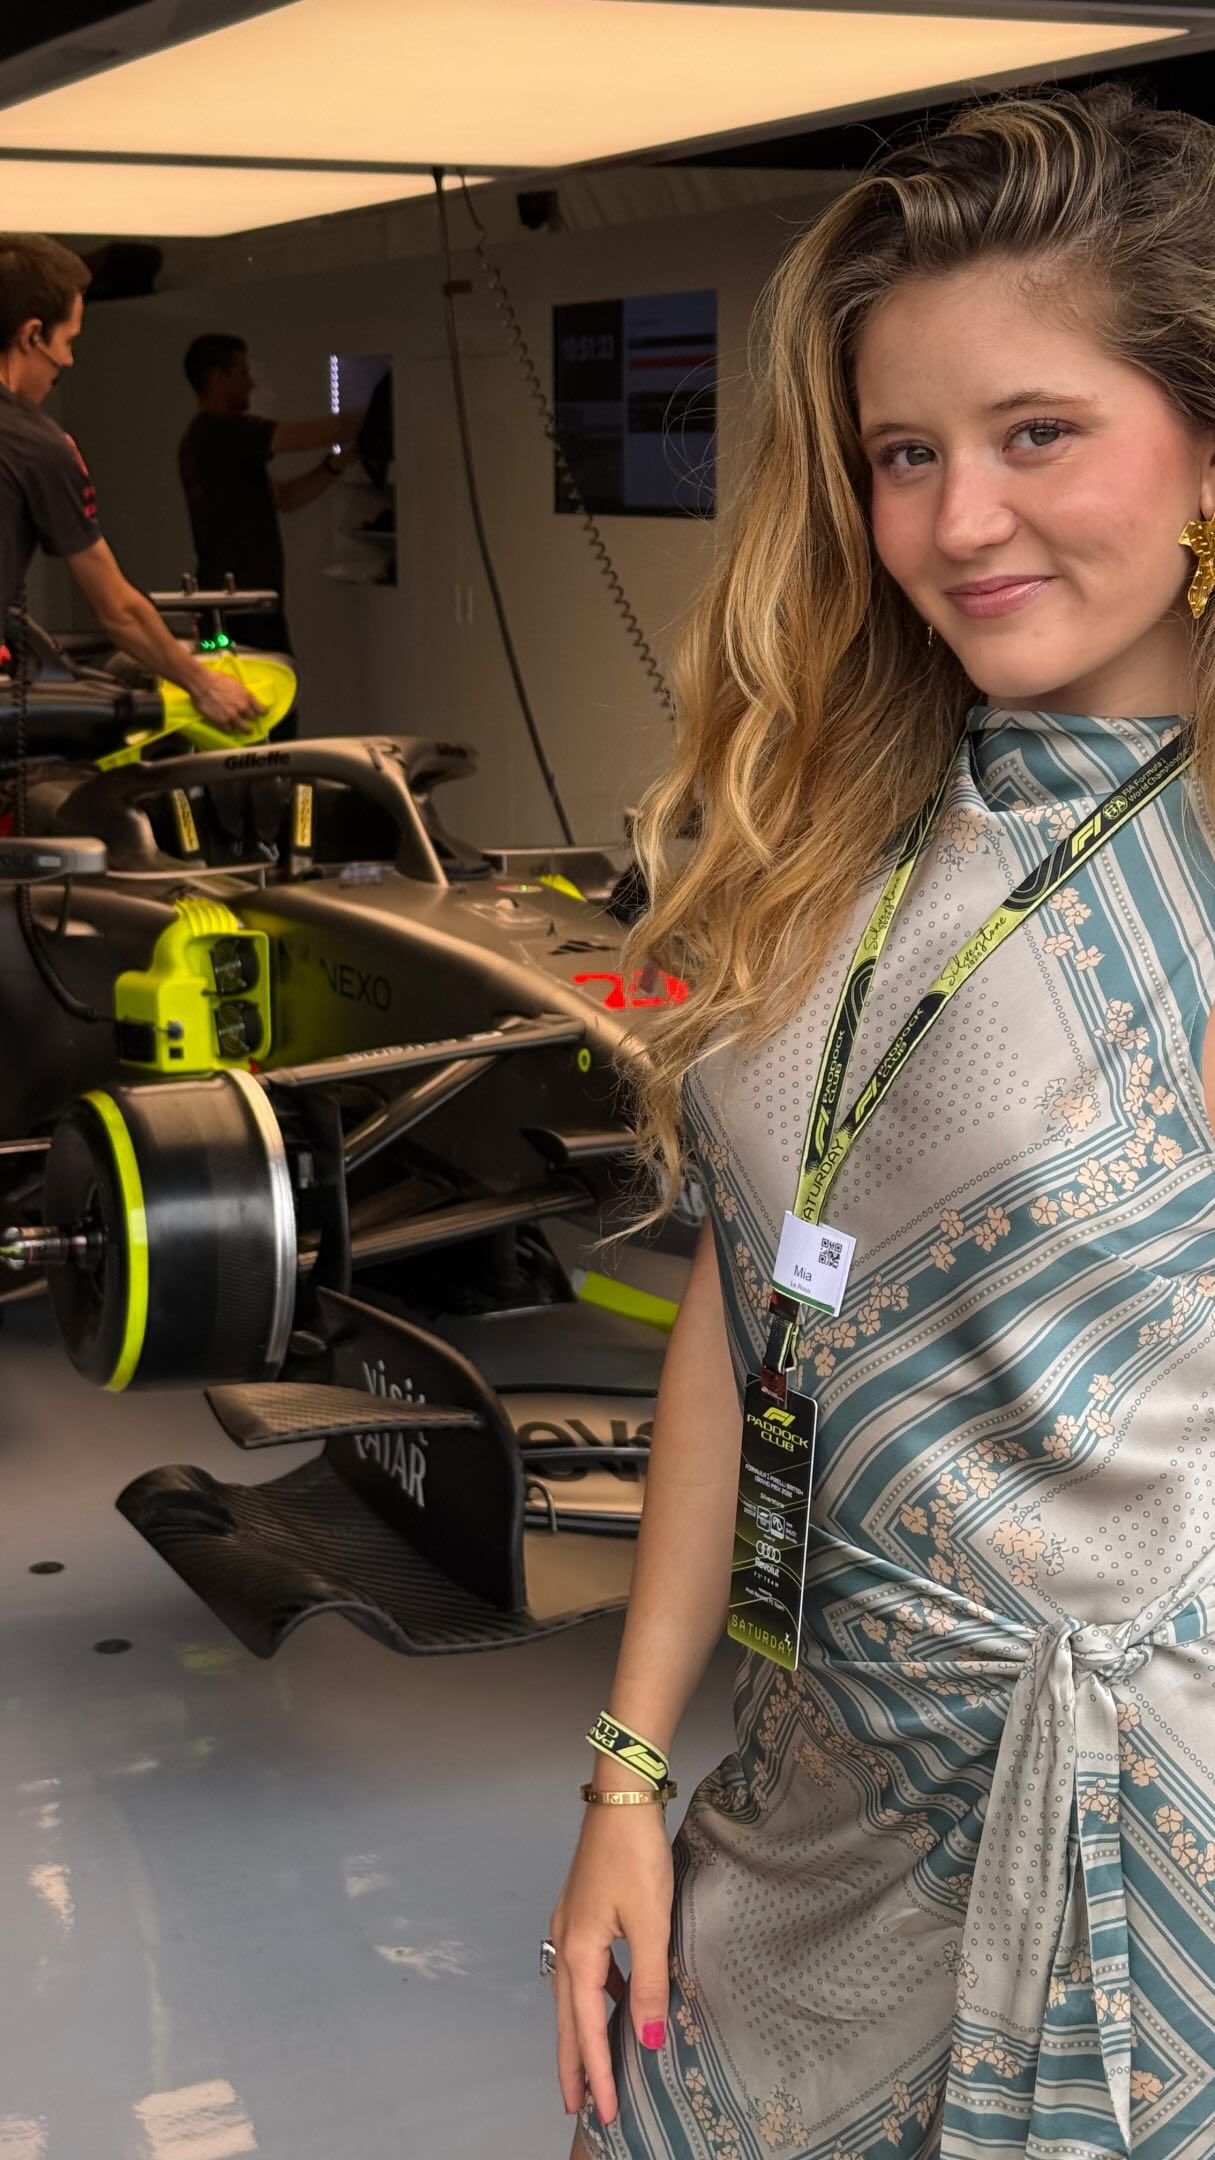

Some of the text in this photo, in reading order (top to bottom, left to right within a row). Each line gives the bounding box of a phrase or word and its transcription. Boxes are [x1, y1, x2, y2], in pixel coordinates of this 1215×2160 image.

[223, 751, 291, 770] Gillette
[1134, 761, 1163, 786] Formula
[1128, 783, 1149, 802] World
[940, 916, 1007, 986] Silverstone
[878, 1007, 924, 1076] PADDOCK
[882, 1041, 908, 1078] CLUB
[822, 1029, 846, 1104] PADDOCK
[828, 1063, 843, 1104] CLUB
[800, 1138, 844, 1222] ATURDAY
[794, 1264, 812, 1281] Mia
[746, 1413, 809, 1449] PADDOCK
[760, 1430, 794, 1452] CLUB
[755, 1556, 780, 1578] Revolut
[731, 1614, 793, 1657] SATURDAY
